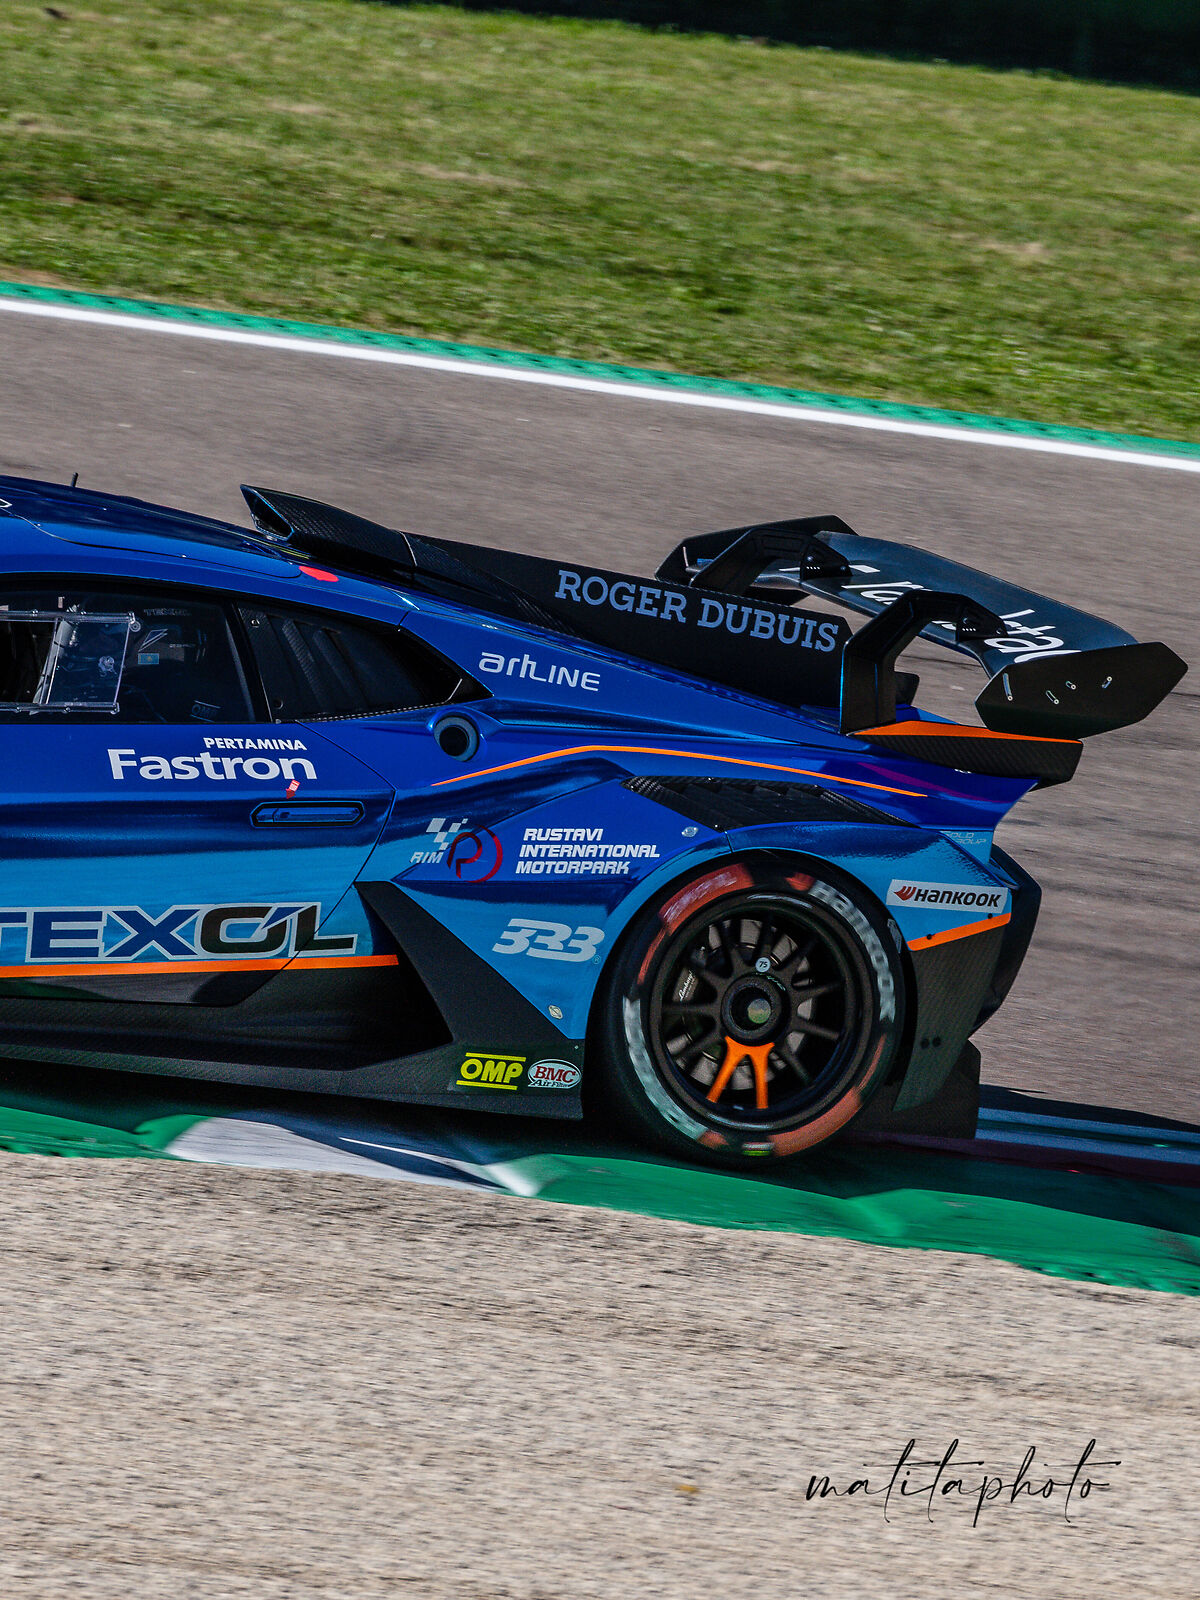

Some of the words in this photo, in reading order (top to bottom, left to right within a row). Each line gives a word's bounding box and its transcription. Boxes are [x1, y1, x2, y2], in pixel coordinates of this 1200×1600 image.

[554, 570, 689, 624] ROGER
[697, 596, 840, 653] DUBUIS
[203, 736, 308, 751] PERTAMINA
[107, 748, 317, 780] Fastron
[523, 828, 603, 842] RUSTAVI
[409, 851, 444, 864] RIM
[519, 844, 661, 858] INTERNATIONAL
[515, 861, 630, 875] MOTORPARK
[460, 1058, 524, 1084] OMP
[533, 1065, 576, 1083] BMC
